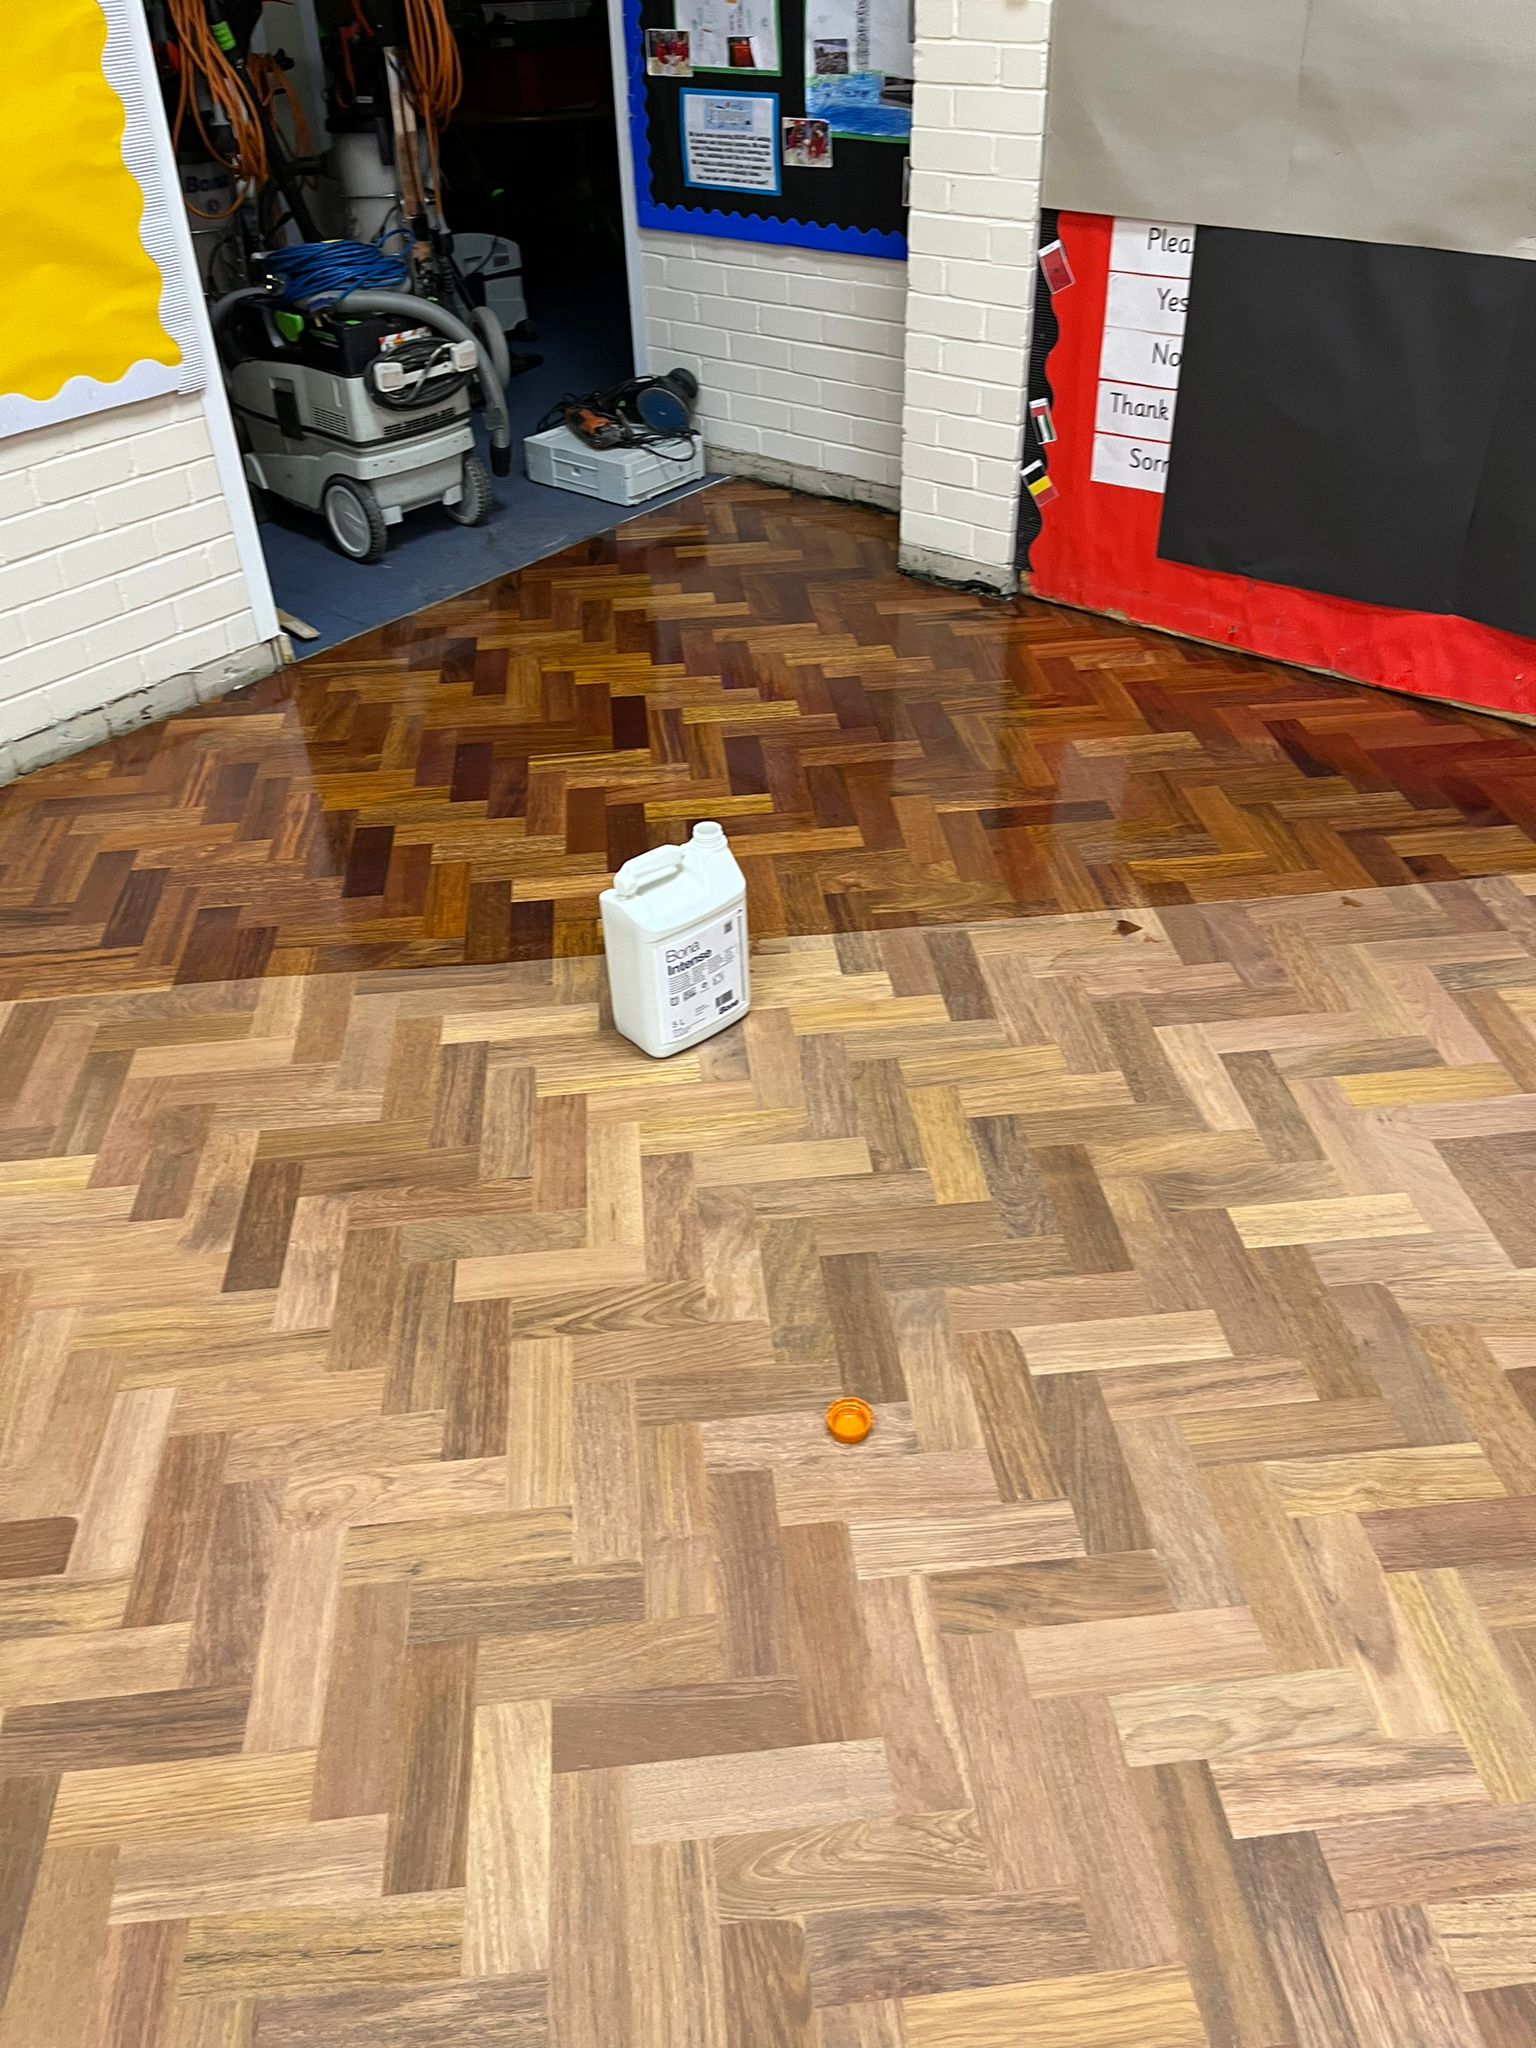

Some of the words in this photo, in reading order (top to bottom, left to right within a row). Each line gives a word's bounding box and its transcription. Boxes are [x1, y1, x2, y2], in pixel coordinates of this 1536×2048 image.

[1157, 287, 1189, 313] Yes
[1152, 343, 1182, 367] No
[1110, 392, 1169, 421] Thank
[666, 941, 700, 963] Bona
[667, 949, 712, 976] Intense
